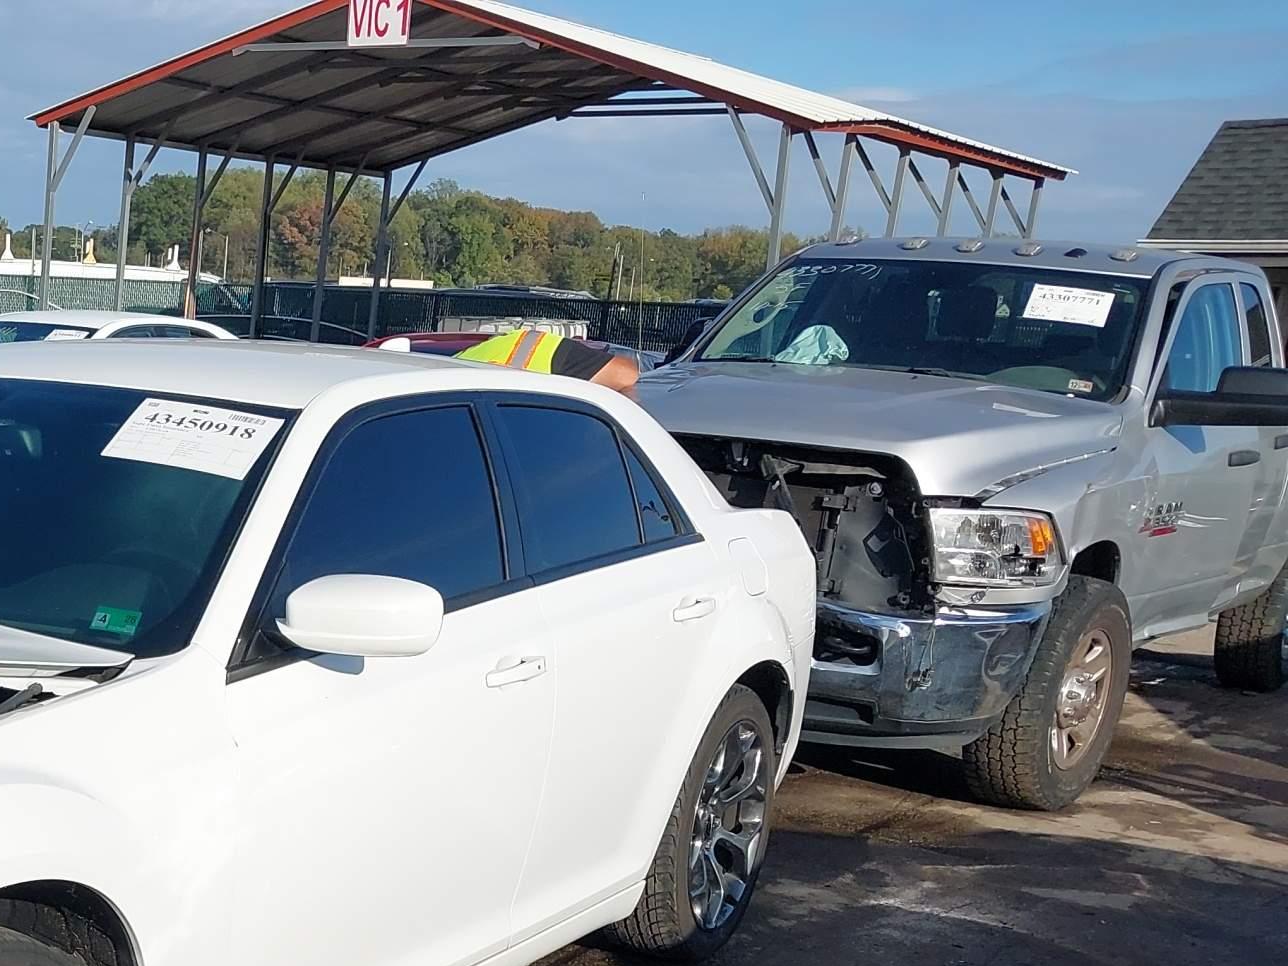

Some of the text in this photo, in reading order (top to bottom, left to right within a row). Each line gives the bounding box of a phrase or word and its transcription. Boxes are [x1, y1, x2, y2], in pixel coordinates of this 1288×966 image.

[352, 0, 409, 37] VIC 1
[144, 412, 256, 440] 43450918
